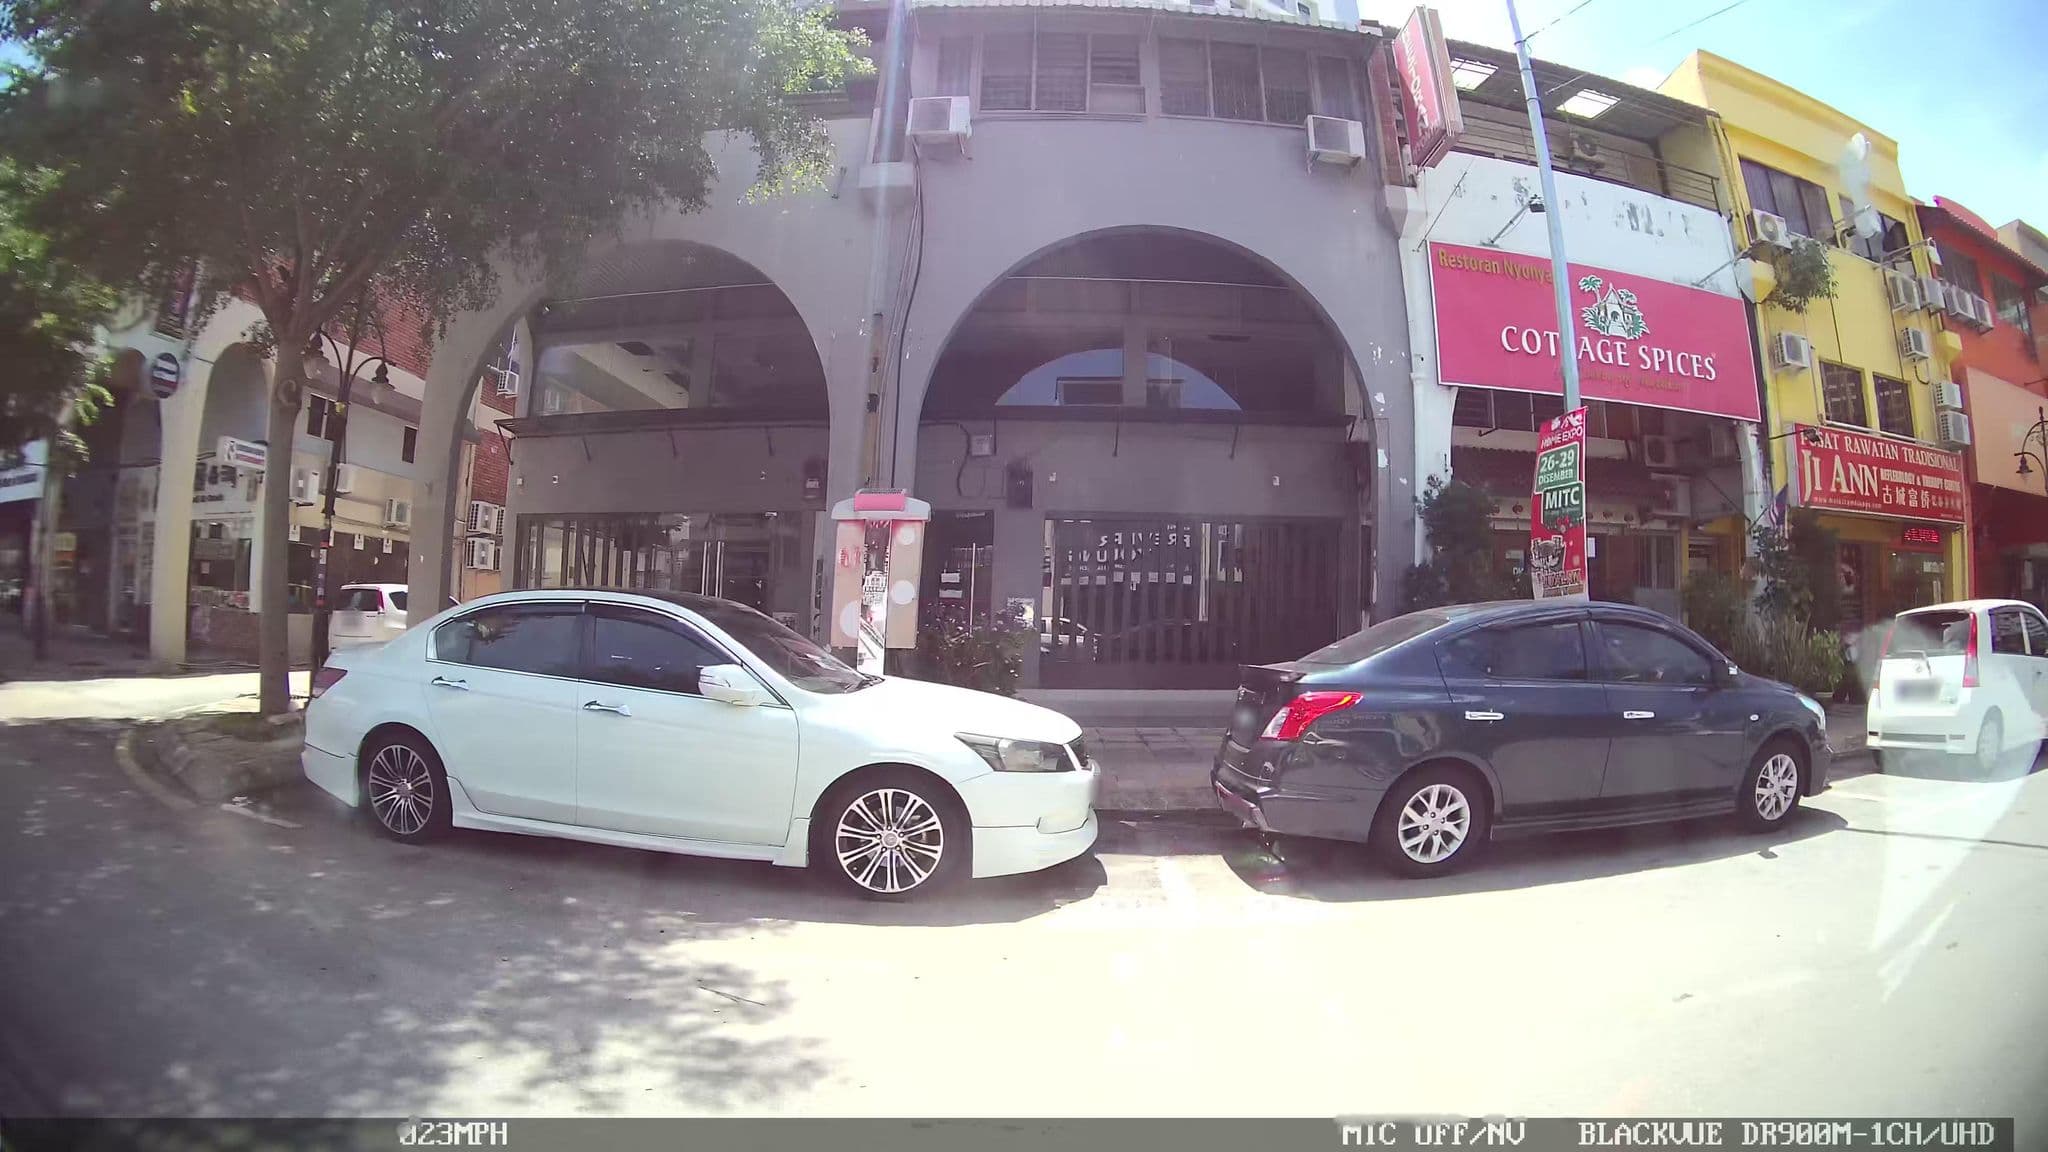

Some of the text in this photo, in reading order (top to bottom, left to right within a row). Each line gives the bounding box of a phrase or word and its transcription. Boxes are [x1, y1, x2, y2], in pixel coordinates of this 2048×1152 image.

[1438, 248, 1501, 274] Restoran
[1500, 325, 1632, 367] COTAGE
[1638, 345, 1717, 381] SPICES
[1540, 449, 1575, 473] 26-29
[1844, 436, 1899, 461] RAWATAN
[1901, 446, 1960, 472] TRADISIONAL
[1545, 486, 1580, 510] MITC
